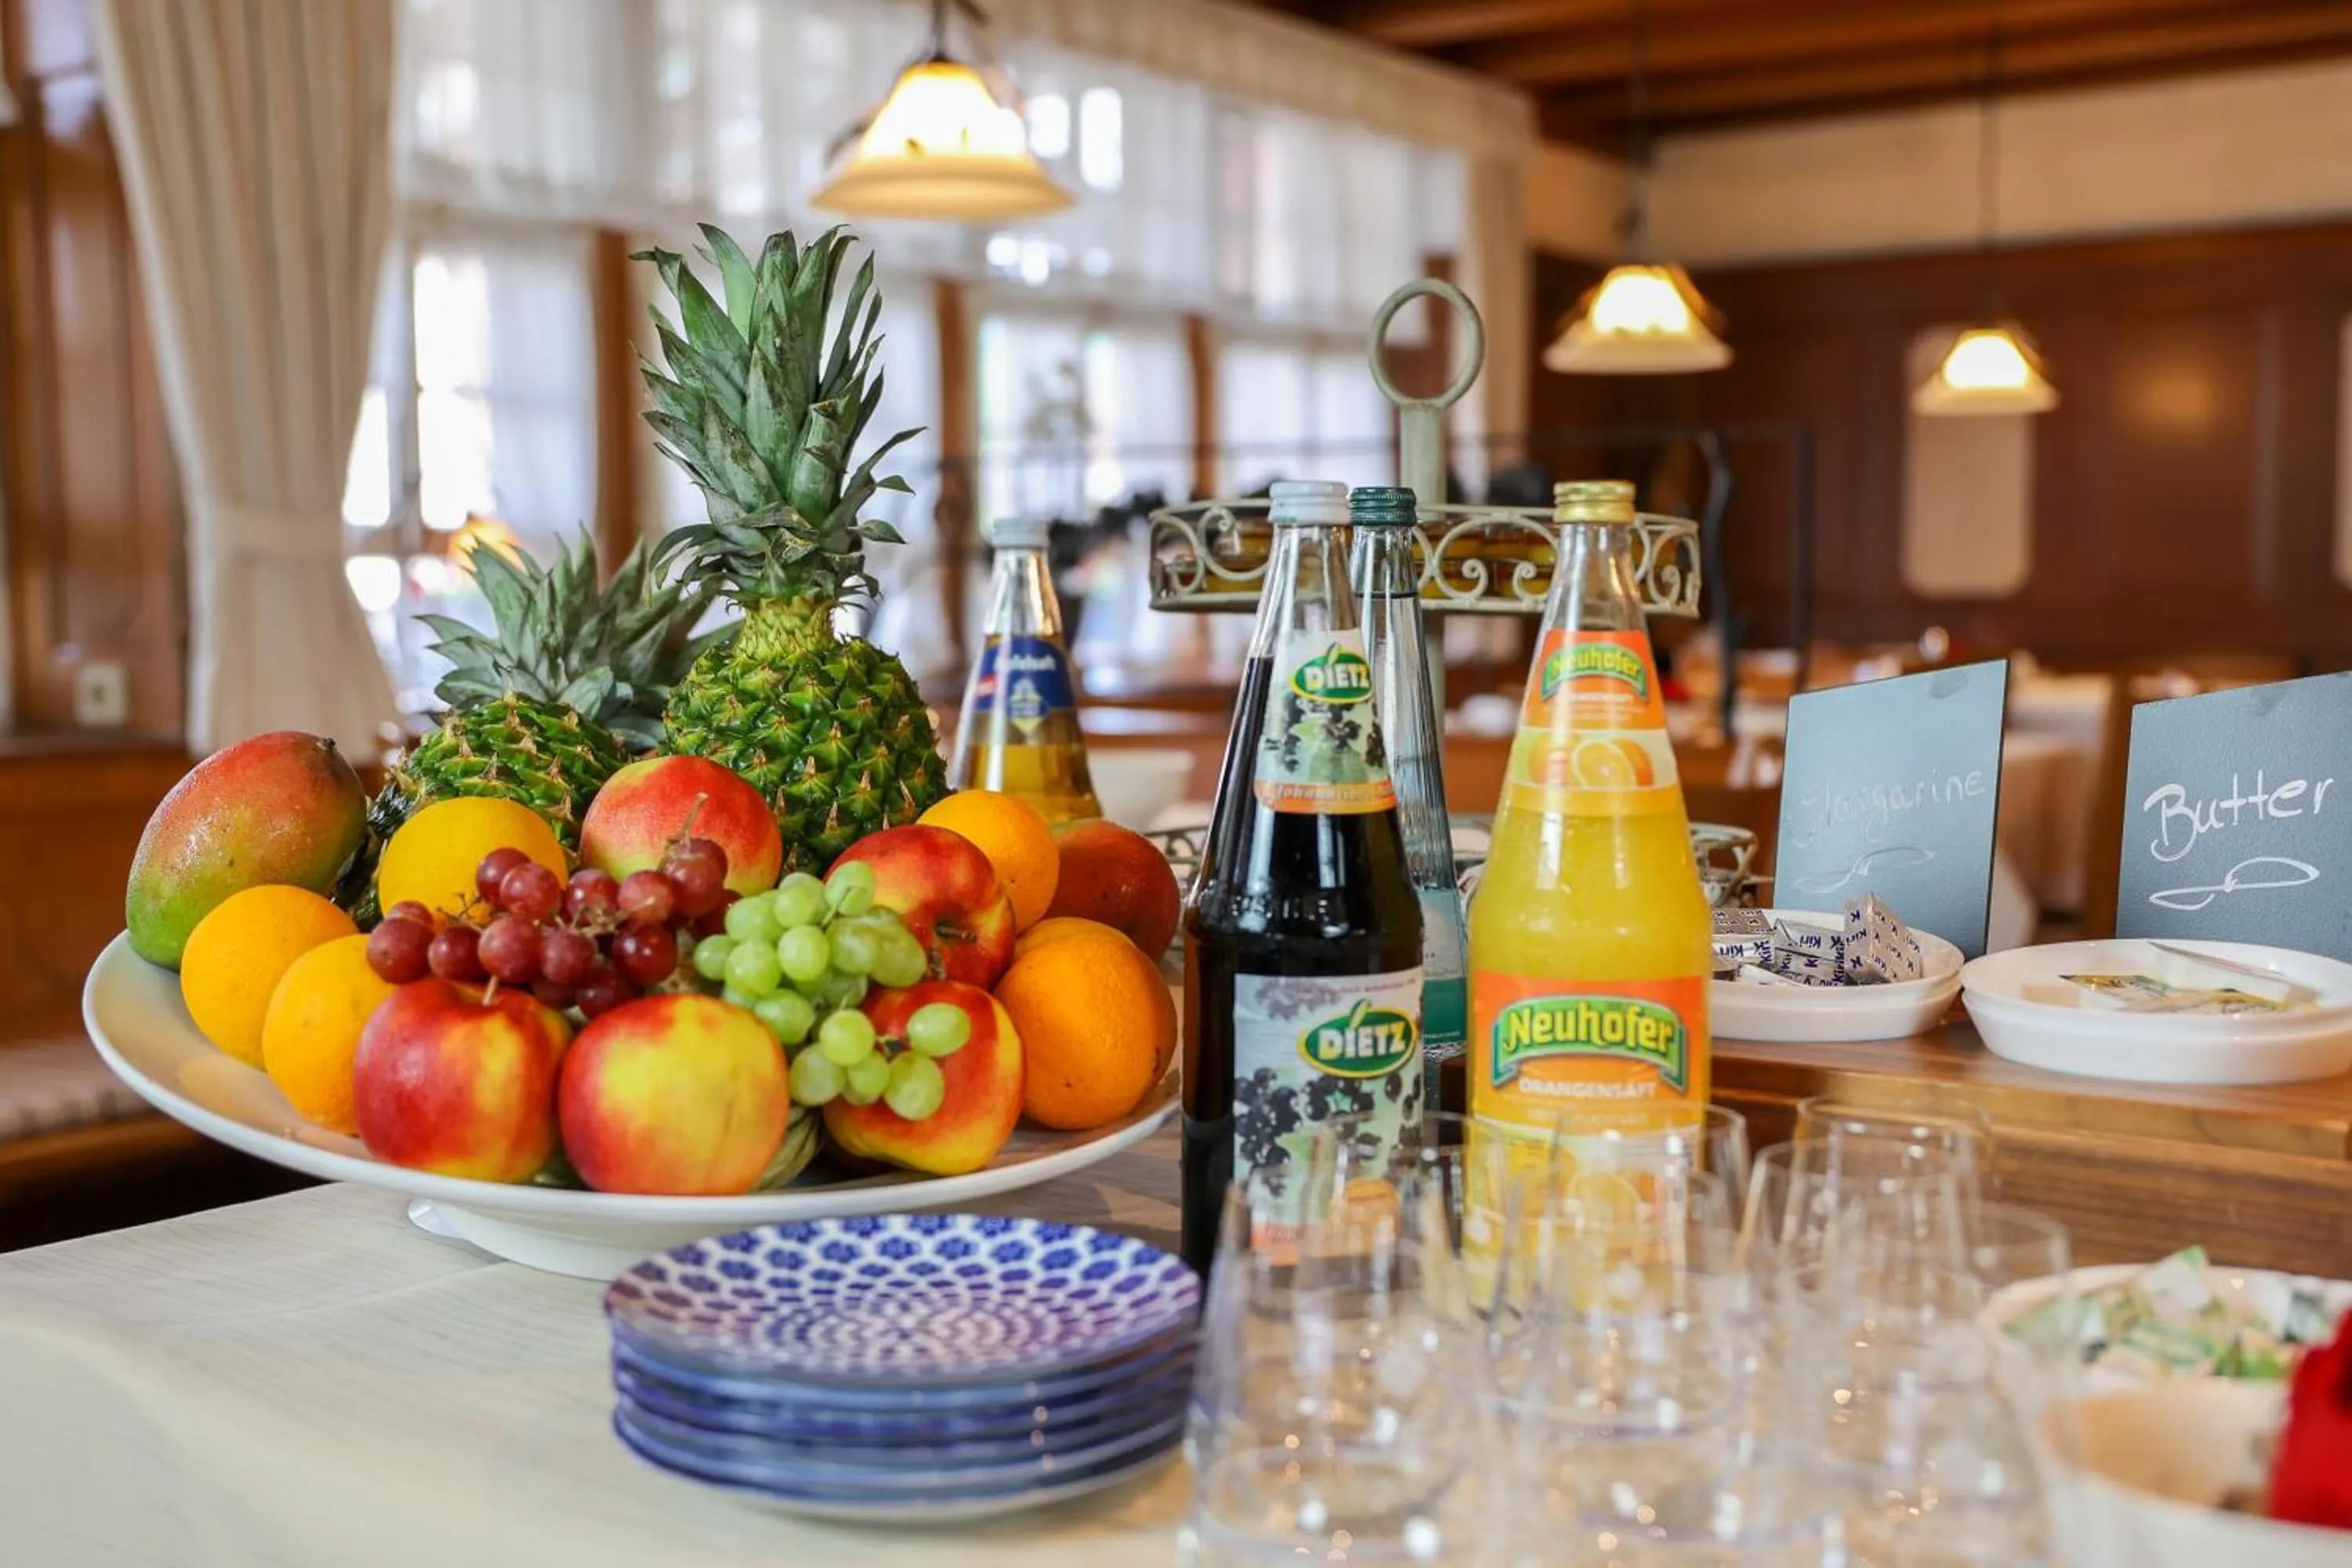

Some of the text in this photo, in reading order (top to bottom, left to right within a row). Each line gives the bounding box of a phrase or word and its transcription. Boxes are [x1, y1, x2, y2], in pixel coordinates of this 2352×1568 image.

[1303, 661, 1371, 691] DIETZ
[2143, 768, 2335, 862] Butter
[1719, 943, 1744, 958] Kiri
[1799, 935, 1821, 949] Kiri
[1317, 1020, 1406, 1061] DIETZ
[1503, 1001, 1673, 1054] Neuhofer
